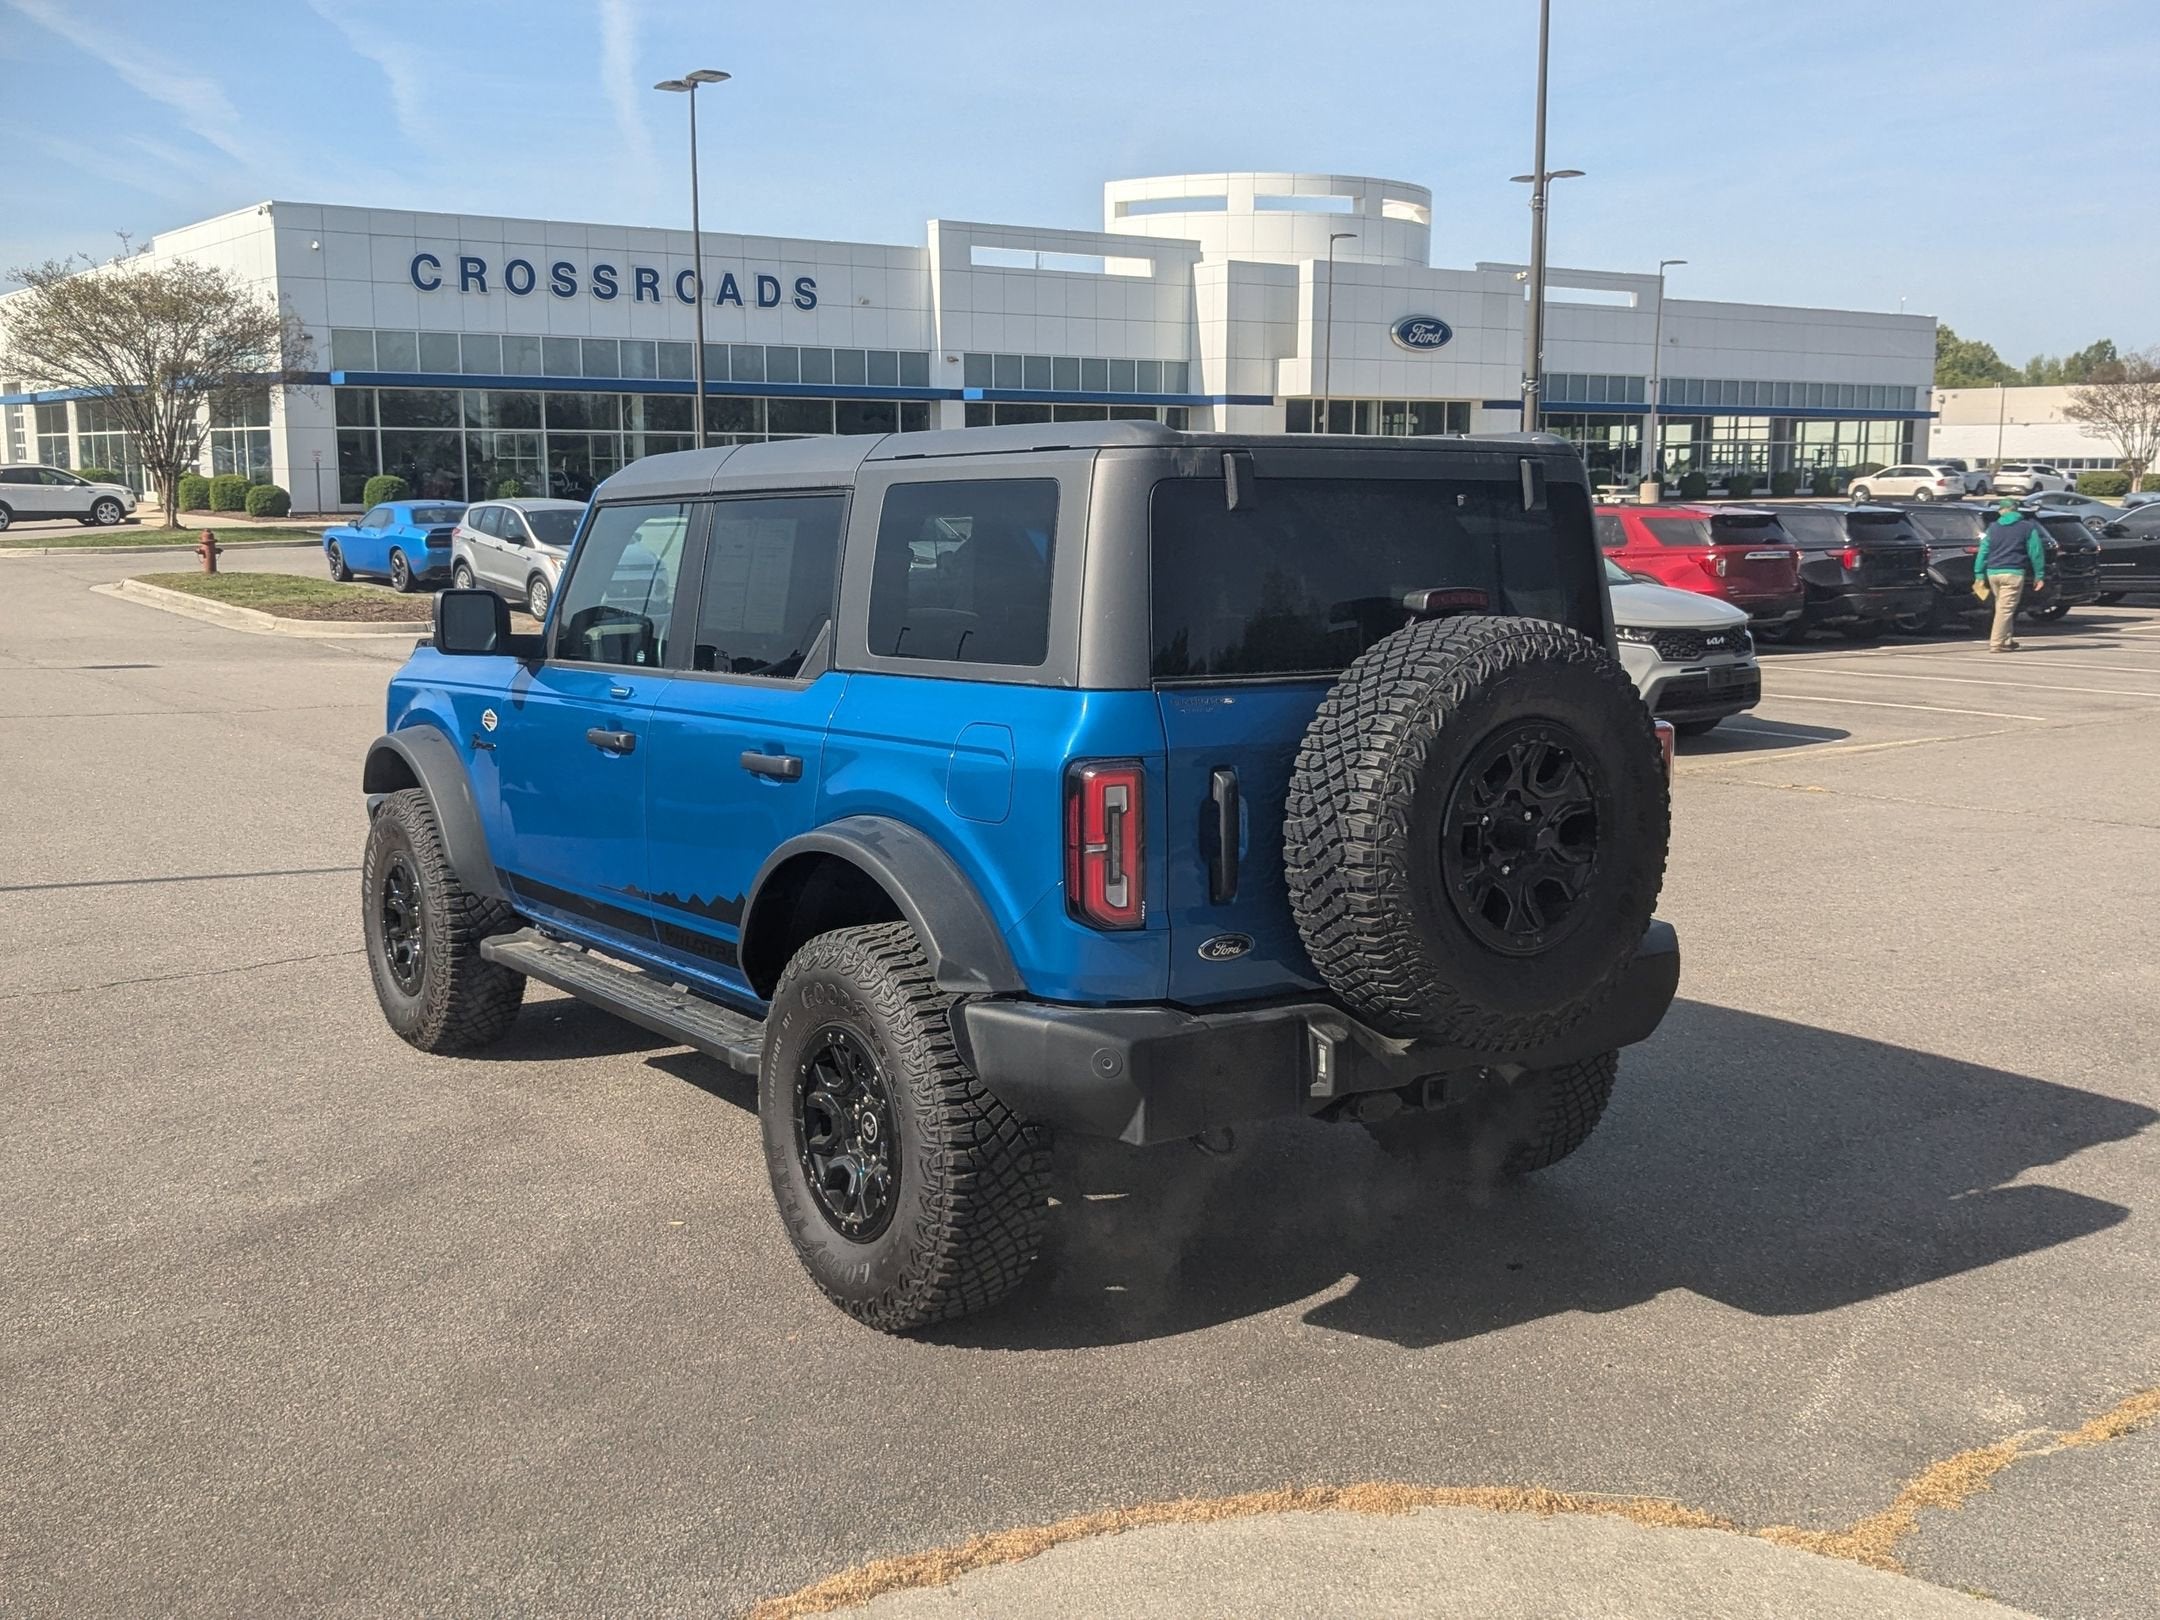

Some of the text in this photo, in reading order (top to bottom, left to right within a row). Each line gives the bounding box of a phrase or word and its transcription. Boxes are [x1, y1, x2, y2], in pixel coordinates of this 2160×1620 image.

[410, 252, 818, 311] CROSSROADS
[1408, 323, 1443, 344] Ford
[1212, 941, 1242, 957] Ford
